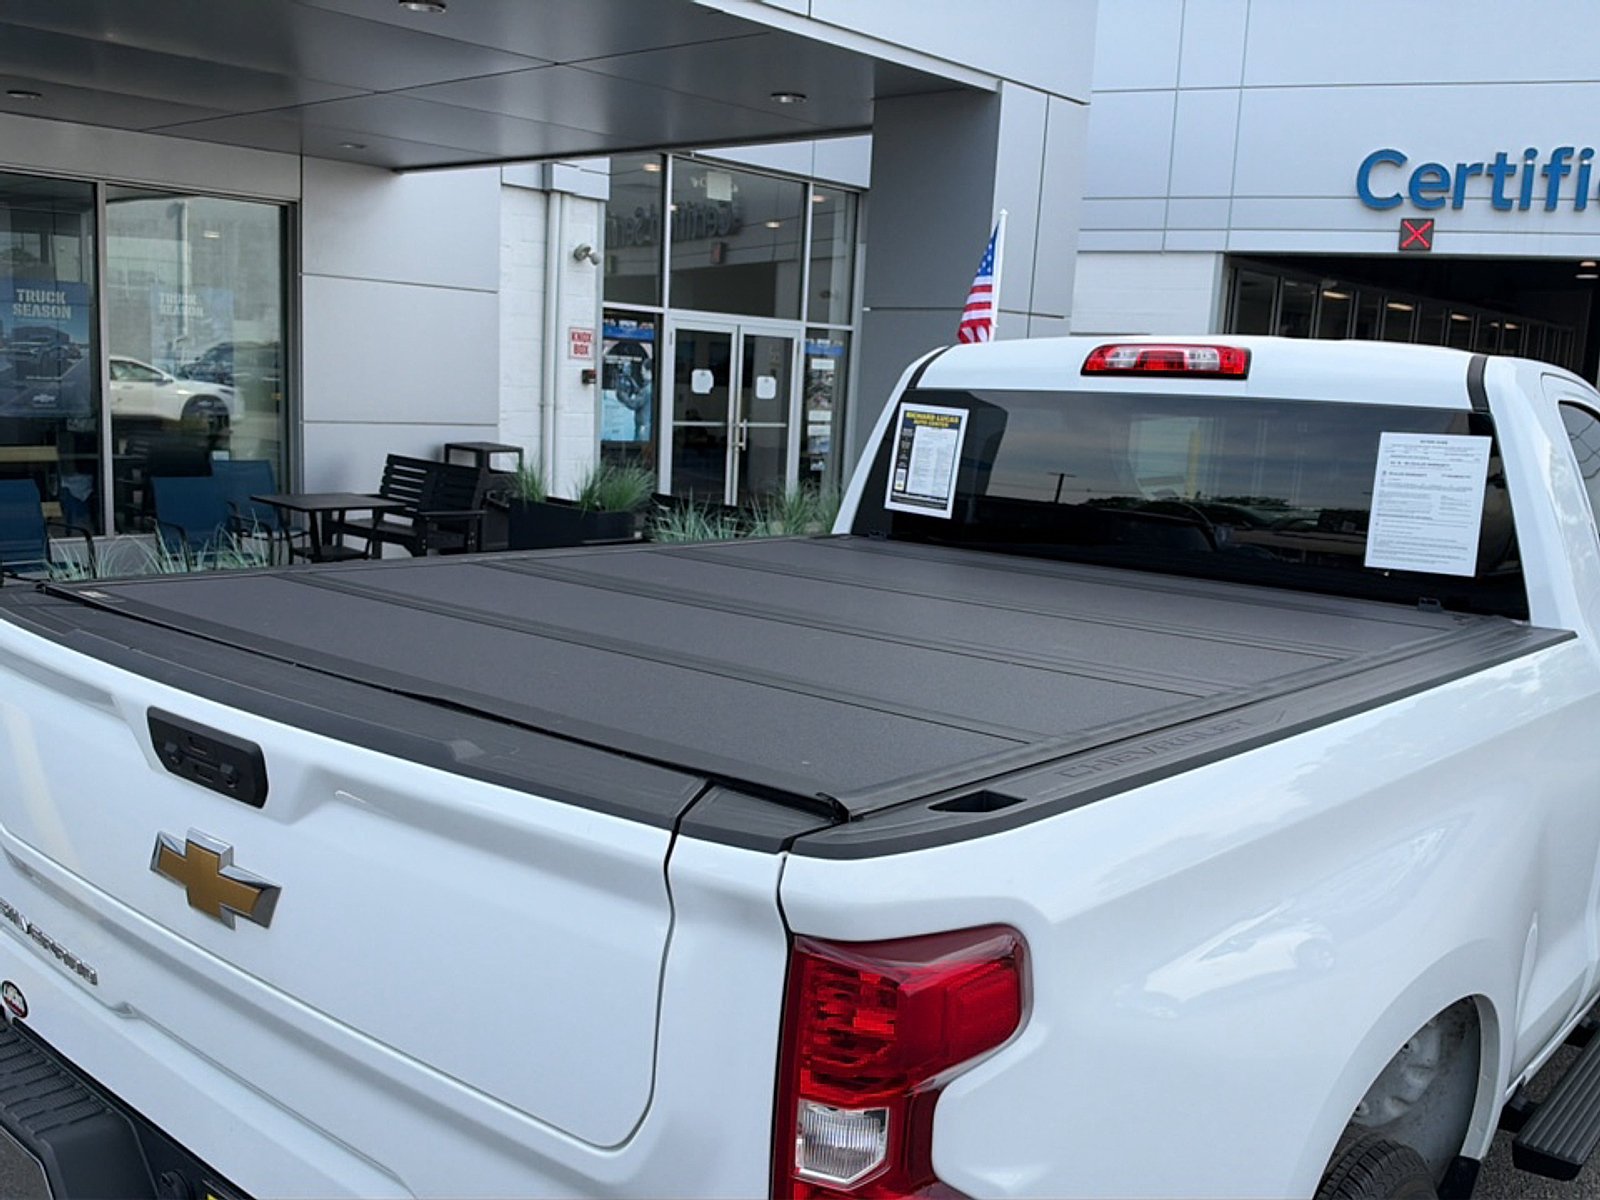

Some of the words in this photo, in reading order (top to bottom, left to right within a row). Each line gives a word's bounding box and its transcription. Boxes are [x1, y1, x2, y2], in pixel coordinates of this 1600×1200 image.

[1356, 147, 1600, 212] Certifi
[16, 288, 66, 304] TRUCK
[13, 303, 71, 319] SEASON
[573, 343, 589, 355] BOX
[1055, 718, 1249, 778] CHEVROLET
